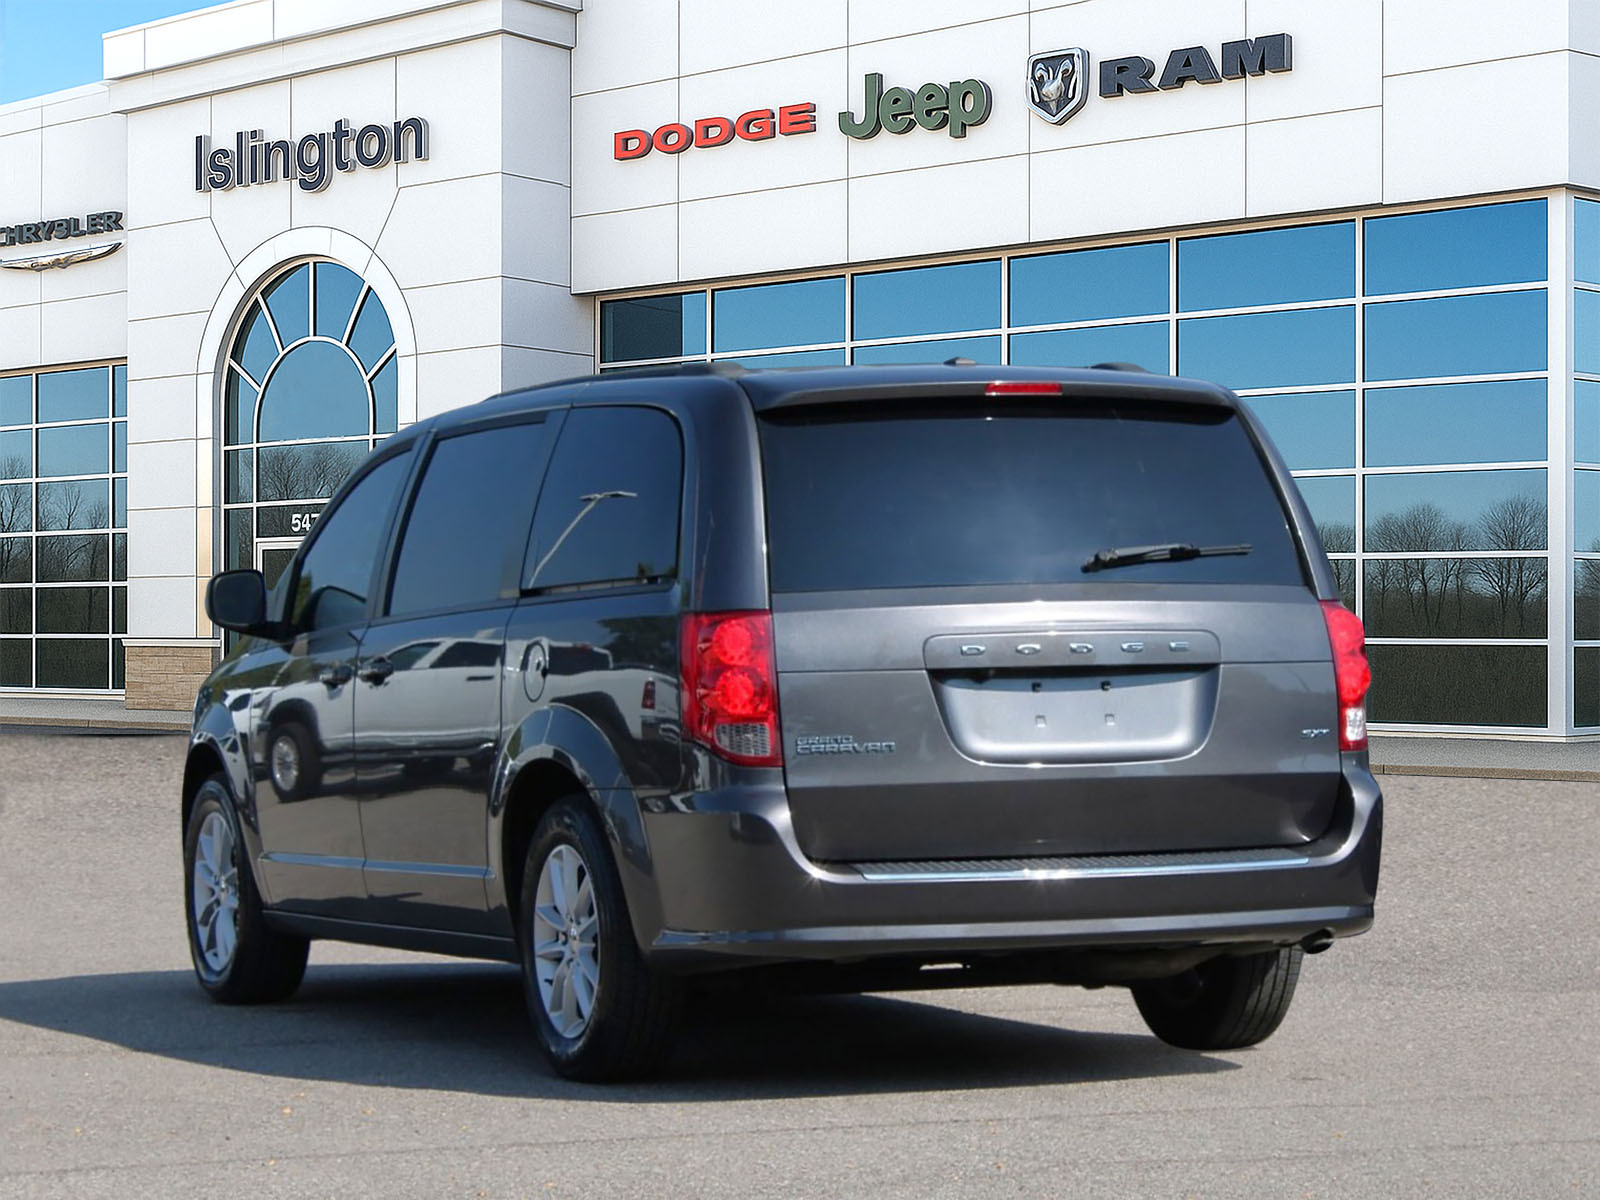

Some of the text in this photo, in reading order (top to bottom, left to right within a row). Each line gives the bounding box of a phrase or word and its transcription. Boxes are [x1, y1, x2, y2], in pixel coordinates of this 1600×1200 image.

[1099, 32, 1293, 98] RAM
[613, 102, 817, 161] DODGE
[838, 72, 992, 140] Jeep
[195, 115, 430, 193] Islington
[960, 642, 1191, 656] DODGE
[797, 742, 895, 755] CARAVAN
